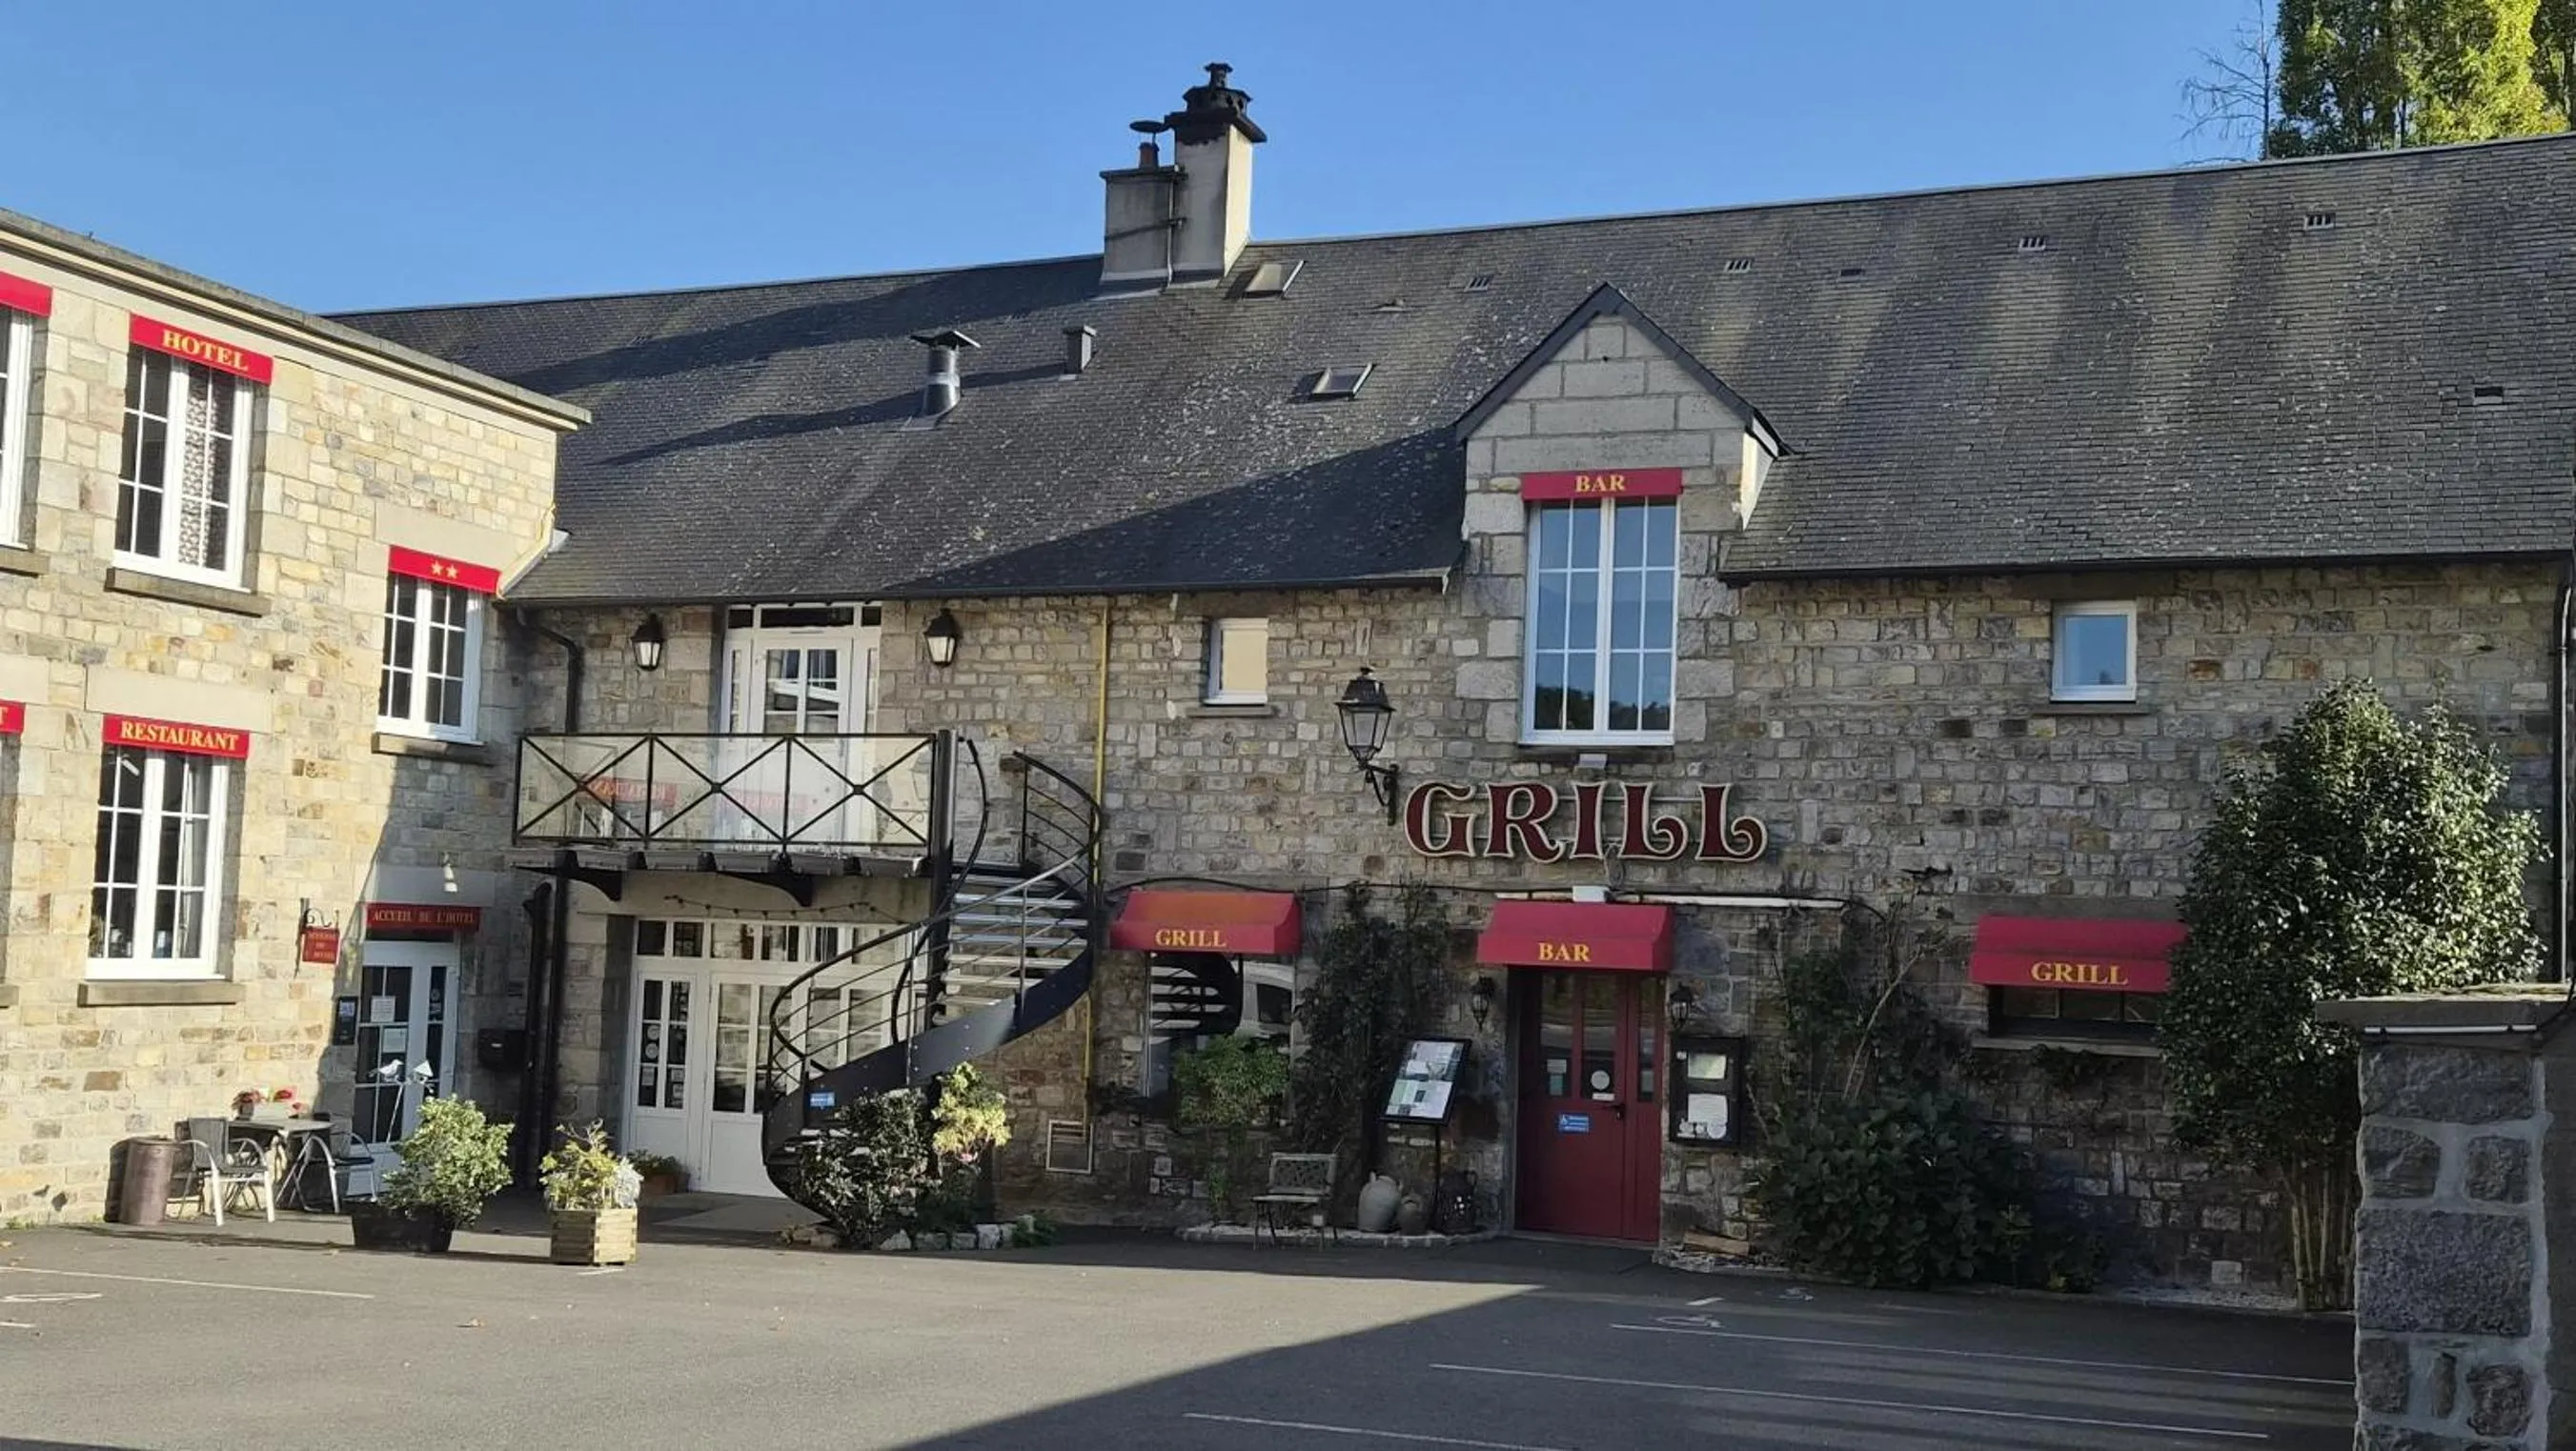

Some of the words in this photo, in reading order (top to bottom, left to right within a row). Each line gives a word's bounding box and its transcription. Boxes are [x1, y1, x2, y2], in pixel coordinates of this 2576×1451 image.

[162, 328, 249, 372] HOTEL
[1575, 474, 1626, 493] BAR
[120, 719, 239, 751] RESTAURANT
[1404, 781, 1768, 863] GRILL
[1155, 928, 1227, 948] GRILL
[1538, 941, 1591, 962] BAR
[2031, 960, 2129, 986] GRILL
